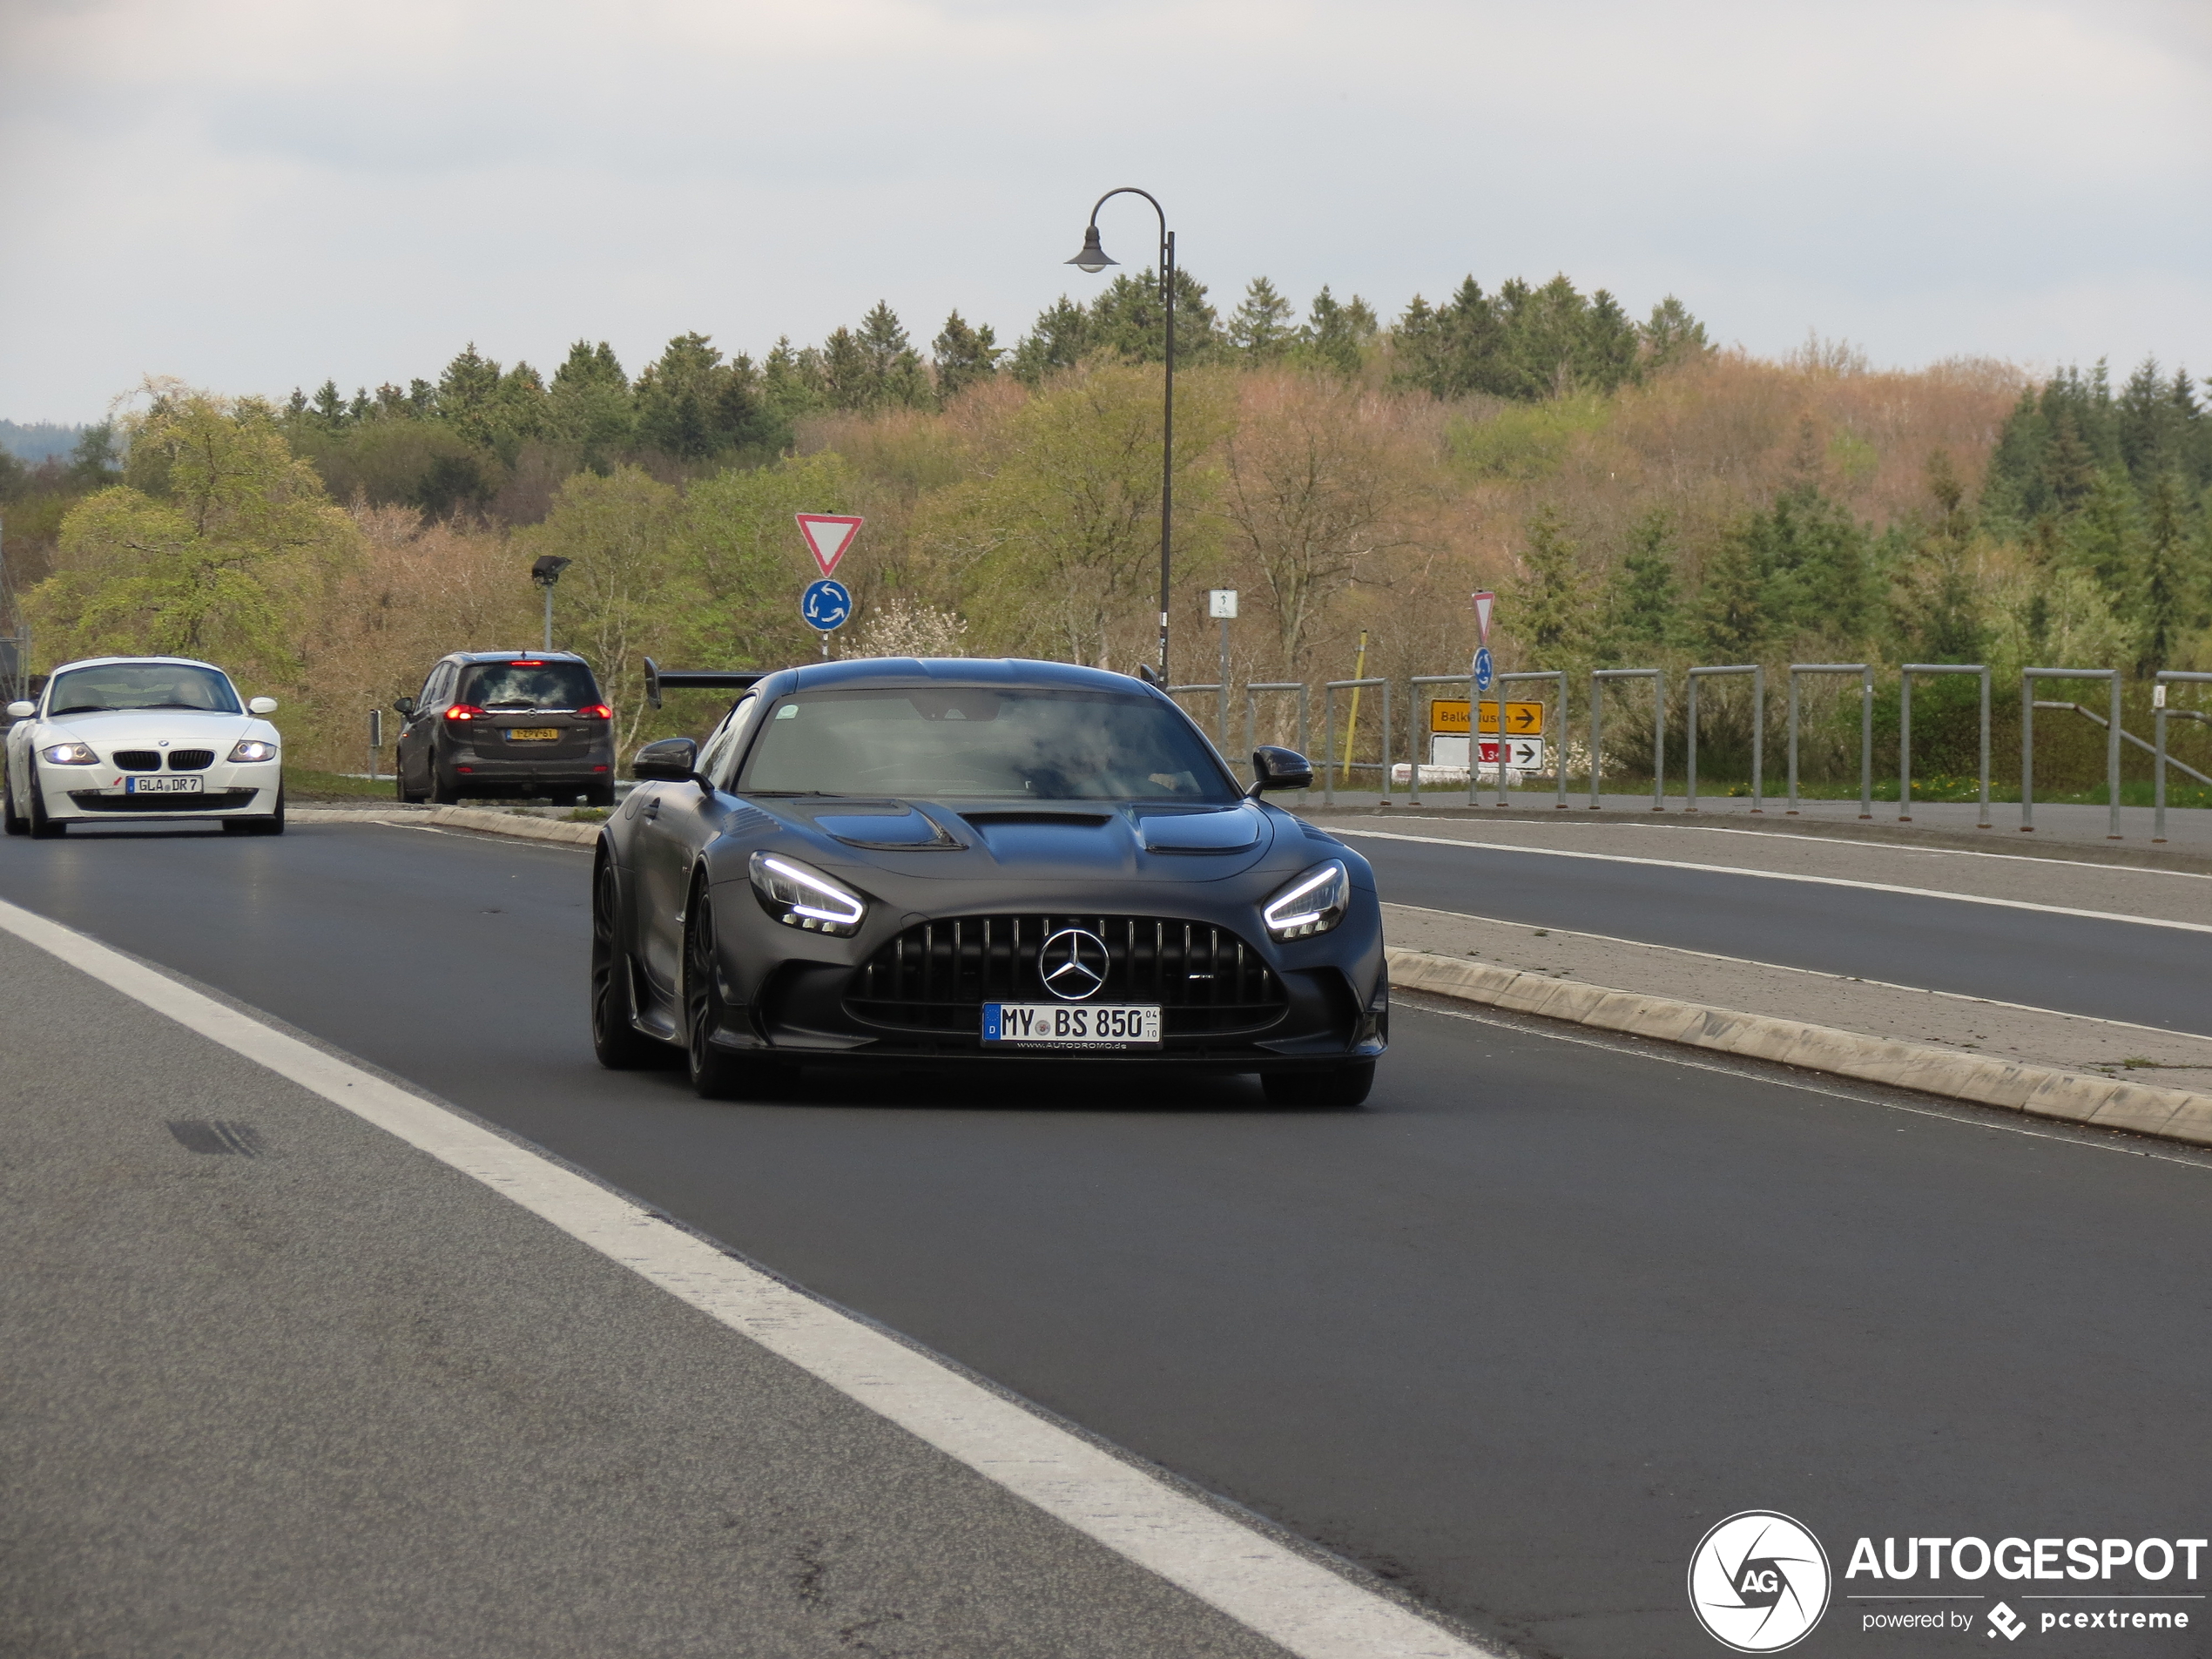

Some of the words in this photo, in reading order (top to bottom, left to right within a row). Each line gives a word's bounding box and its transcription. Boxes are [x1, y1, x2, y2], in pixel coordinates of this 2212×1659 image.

[139, 779, 164, 791] GLA
[172, 779, 187, 791] DR
[191, 779, 198, 791] 7
[1001, 1008, 1035, 1036] MY
[1055, 1008, 1088, 1037] BS
[1096, 1008, 1143, 1037] 850
[988, 1025, 996, 1035] D
[1146, 1029, 1157, 1038] 10
